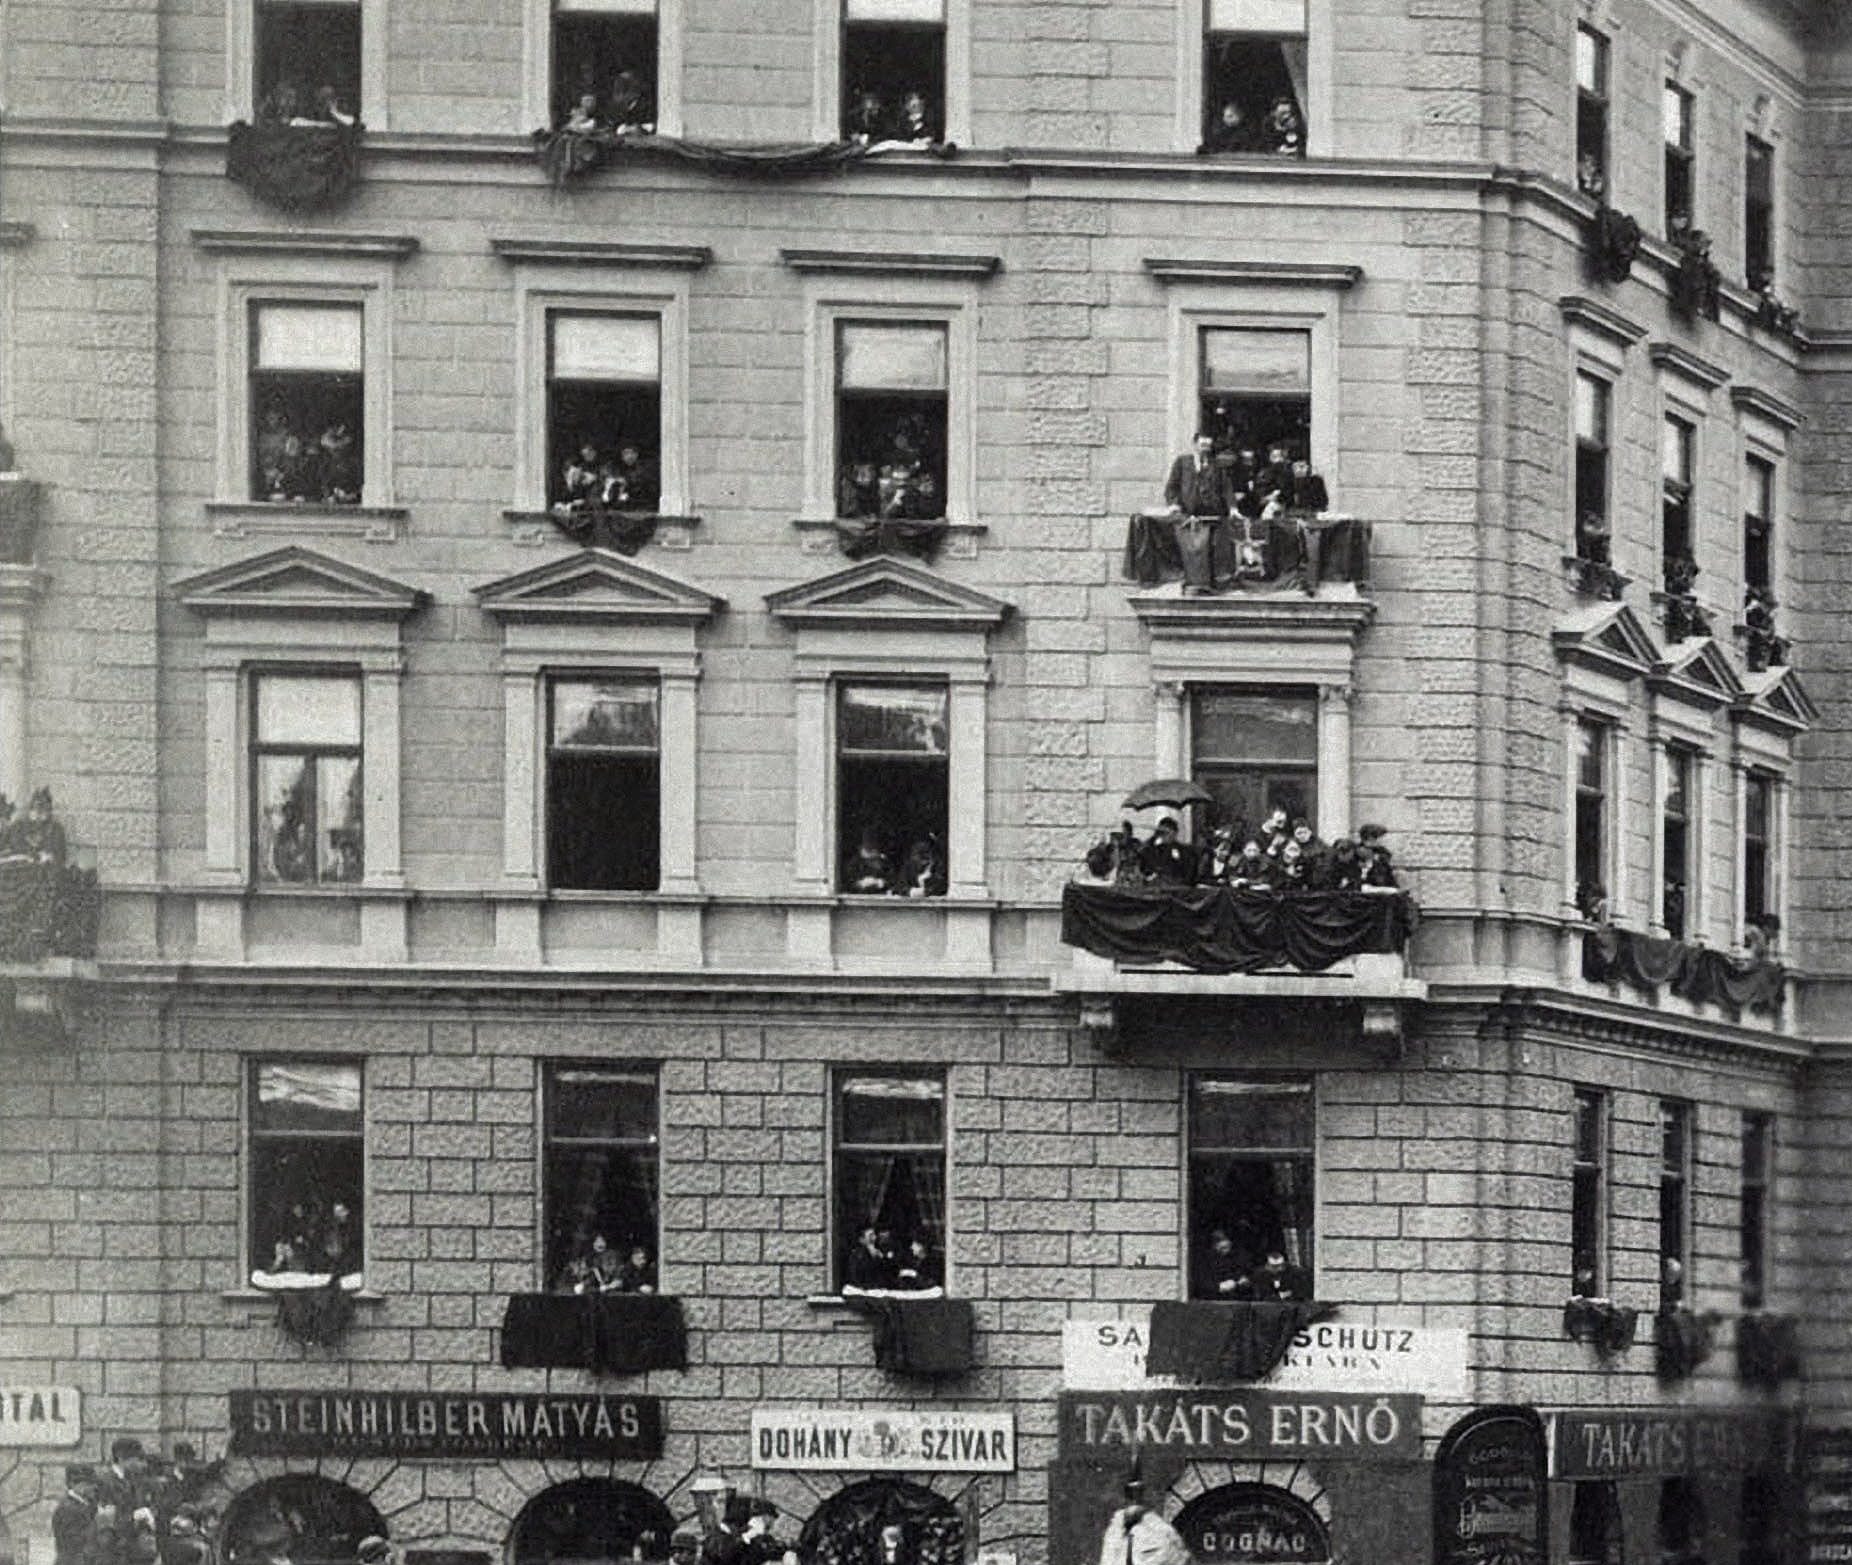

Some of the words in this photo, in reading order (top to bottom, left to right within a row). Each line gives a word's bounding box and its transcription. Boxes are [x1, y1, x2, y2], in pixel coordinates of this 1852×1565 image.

[0, 1391, 67, 1424] TAL
[253, 1398, 490, 1436] STEINHILBER
[1076, 1398, 1250, 1446] TAKÁTS
[758, 1423, 853, 1460] DOHÁNY
